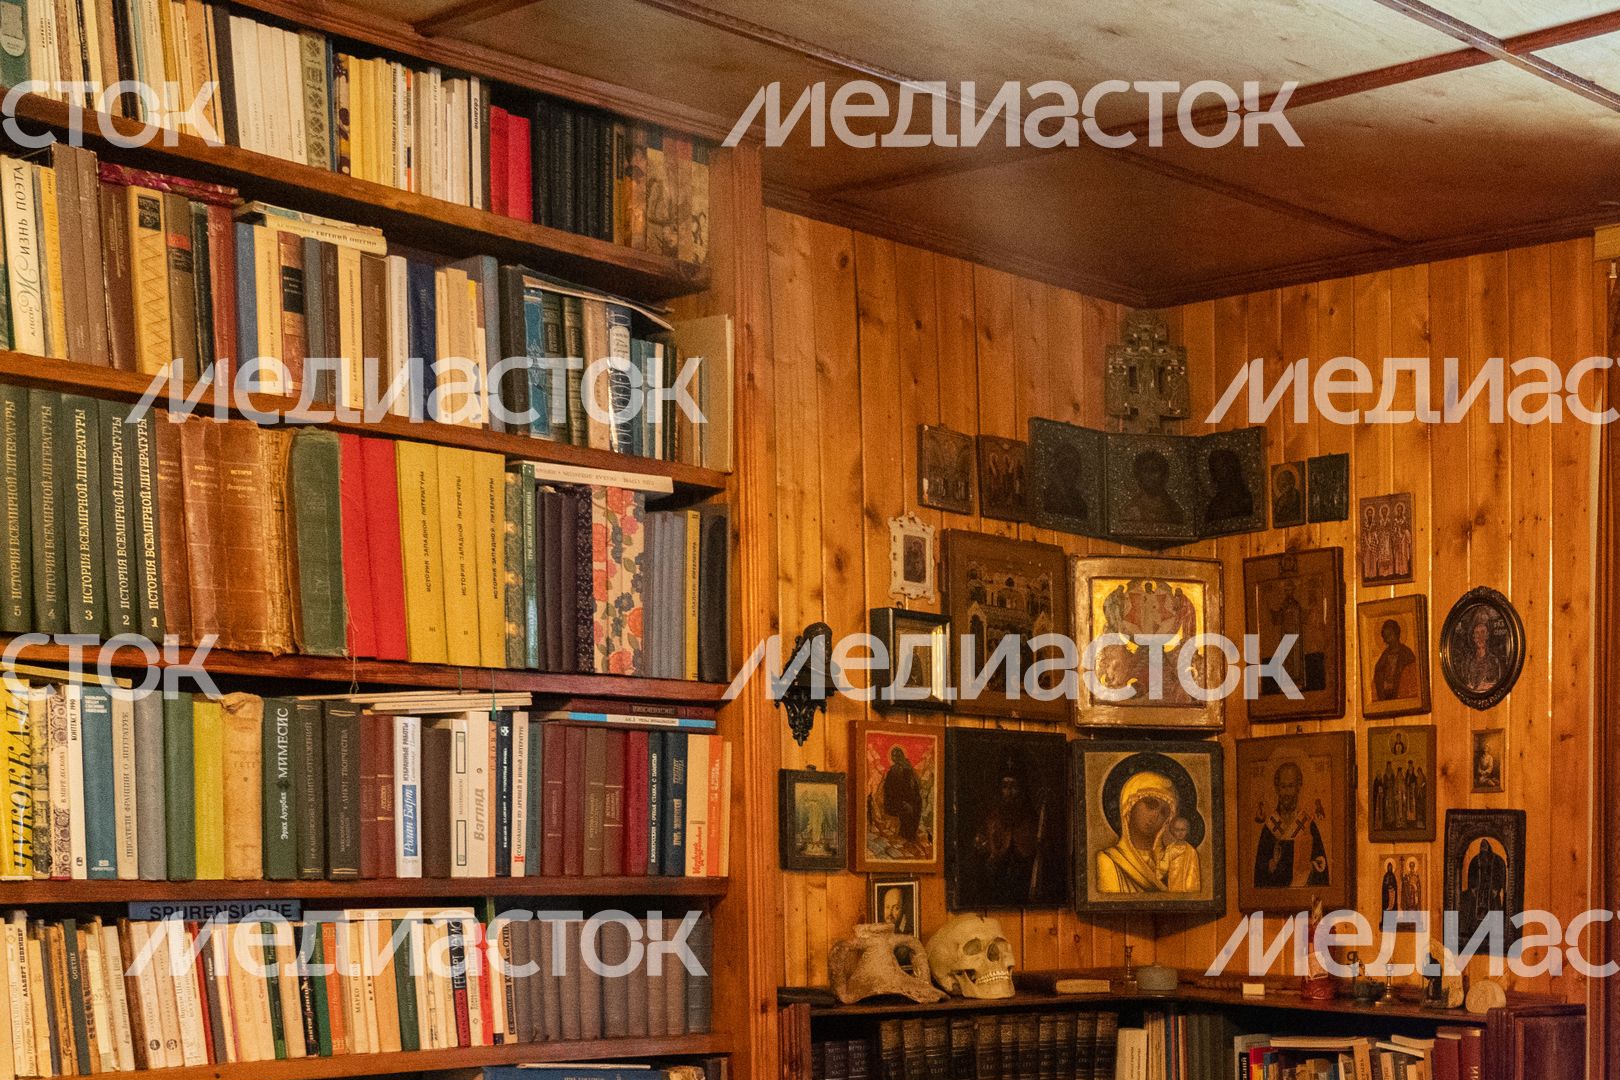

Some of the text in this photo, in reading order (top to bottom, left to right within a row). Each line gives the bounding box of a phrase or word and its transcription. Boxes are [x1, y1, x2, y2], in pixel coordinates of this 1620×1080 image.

[5, 400, 22, 616] 5 ИСТОРИЯ ВСЕМИРНОЙ ЛИТЕРАТУРЫ
[75, 409, 94, 620] 3 ИСТОРИЯ ВСЕМИРНОЙ ЛИТЕРАТУРЫ
[112, 416, 130, 625] 2 ИСТОРИЯ ВСЕМИРНОЙ ЛИТЕРАТУРЫ
[137, 418, 159, 627] 1 ИСТОРИЯ ВСЕМИРНОЙ ЛИТЕРАТУРЫ
[277, 708, 288, 778] МИМЕСИС
[280, 821, 288, 840] Эрих
